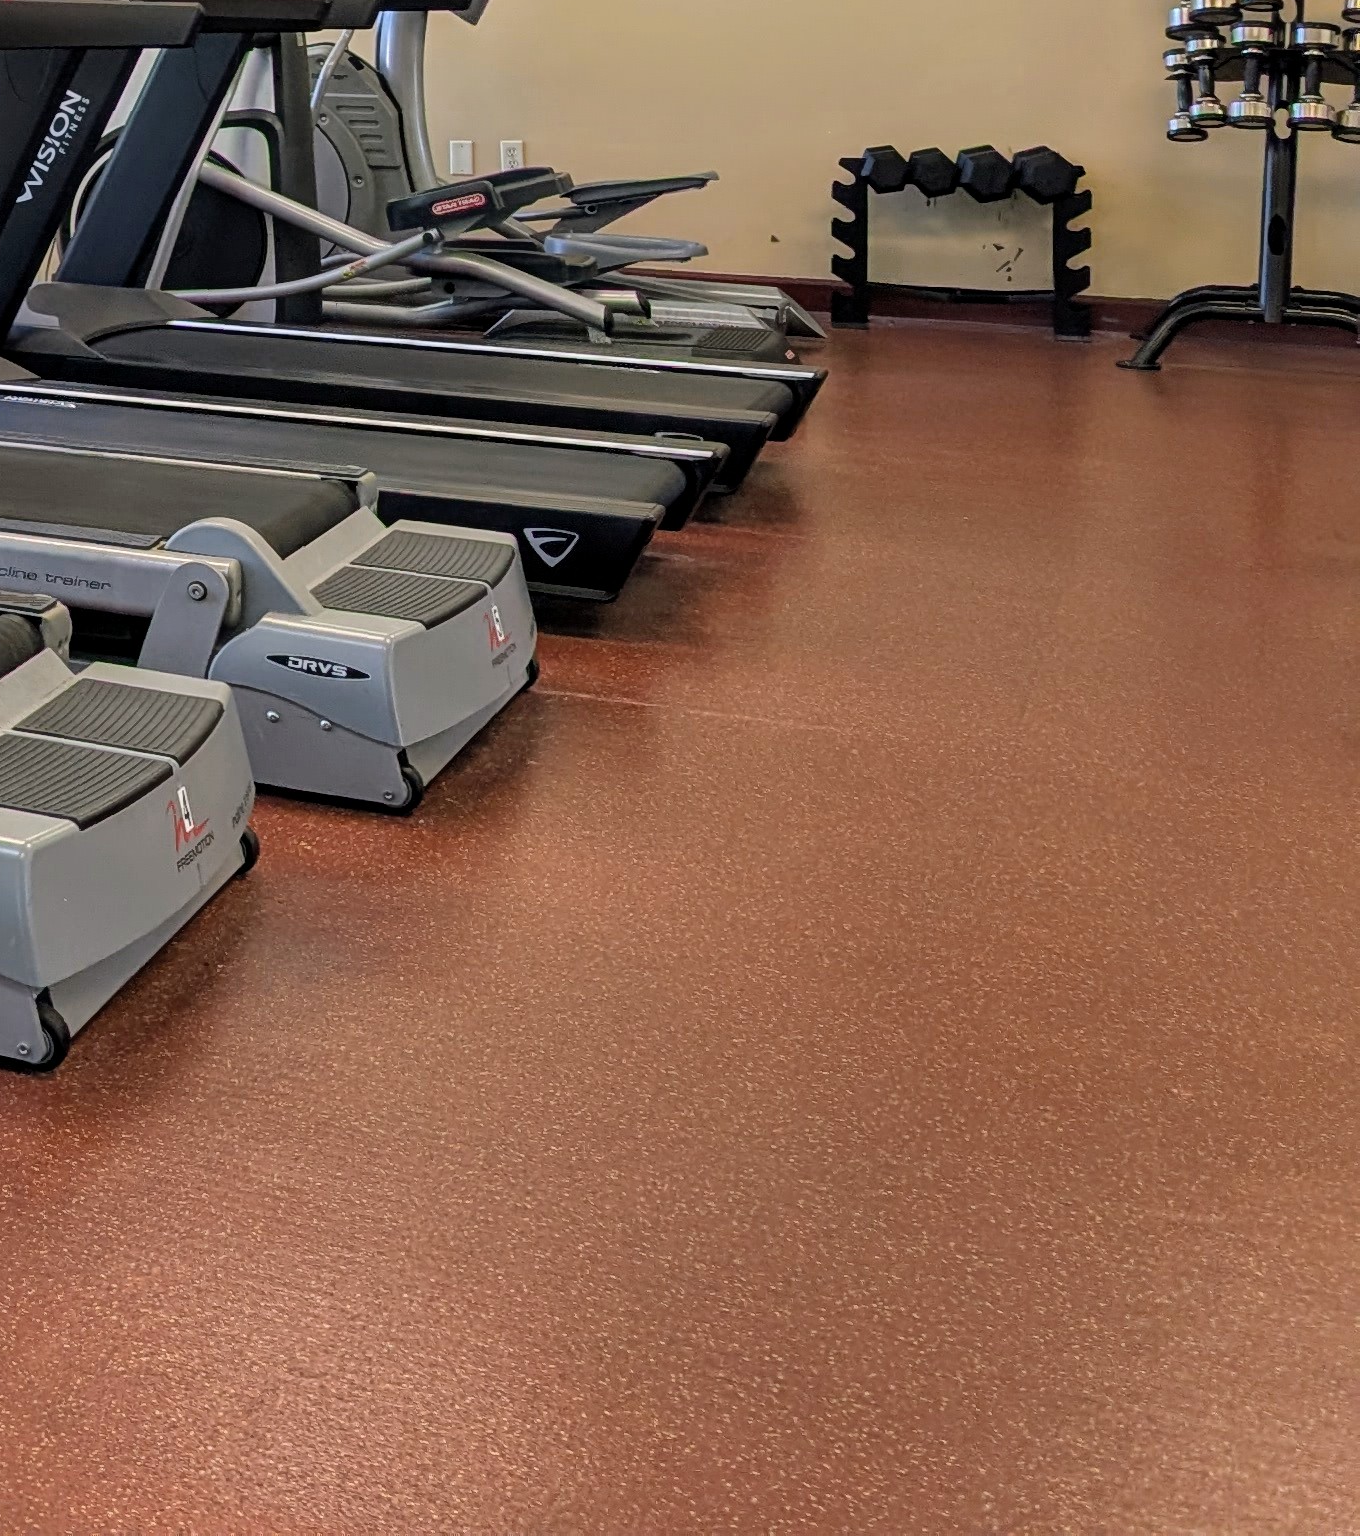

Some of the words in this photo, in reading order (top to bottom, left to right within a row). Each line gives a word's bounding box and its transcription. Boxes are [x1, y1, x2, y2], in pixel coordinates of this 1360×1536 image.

[25, 89, 82, 186] VISION
[58, 97, 90, 155] FITNESS
[45, 572, 112, 590] trainer
[287, 656, 347, 677] DRVS
